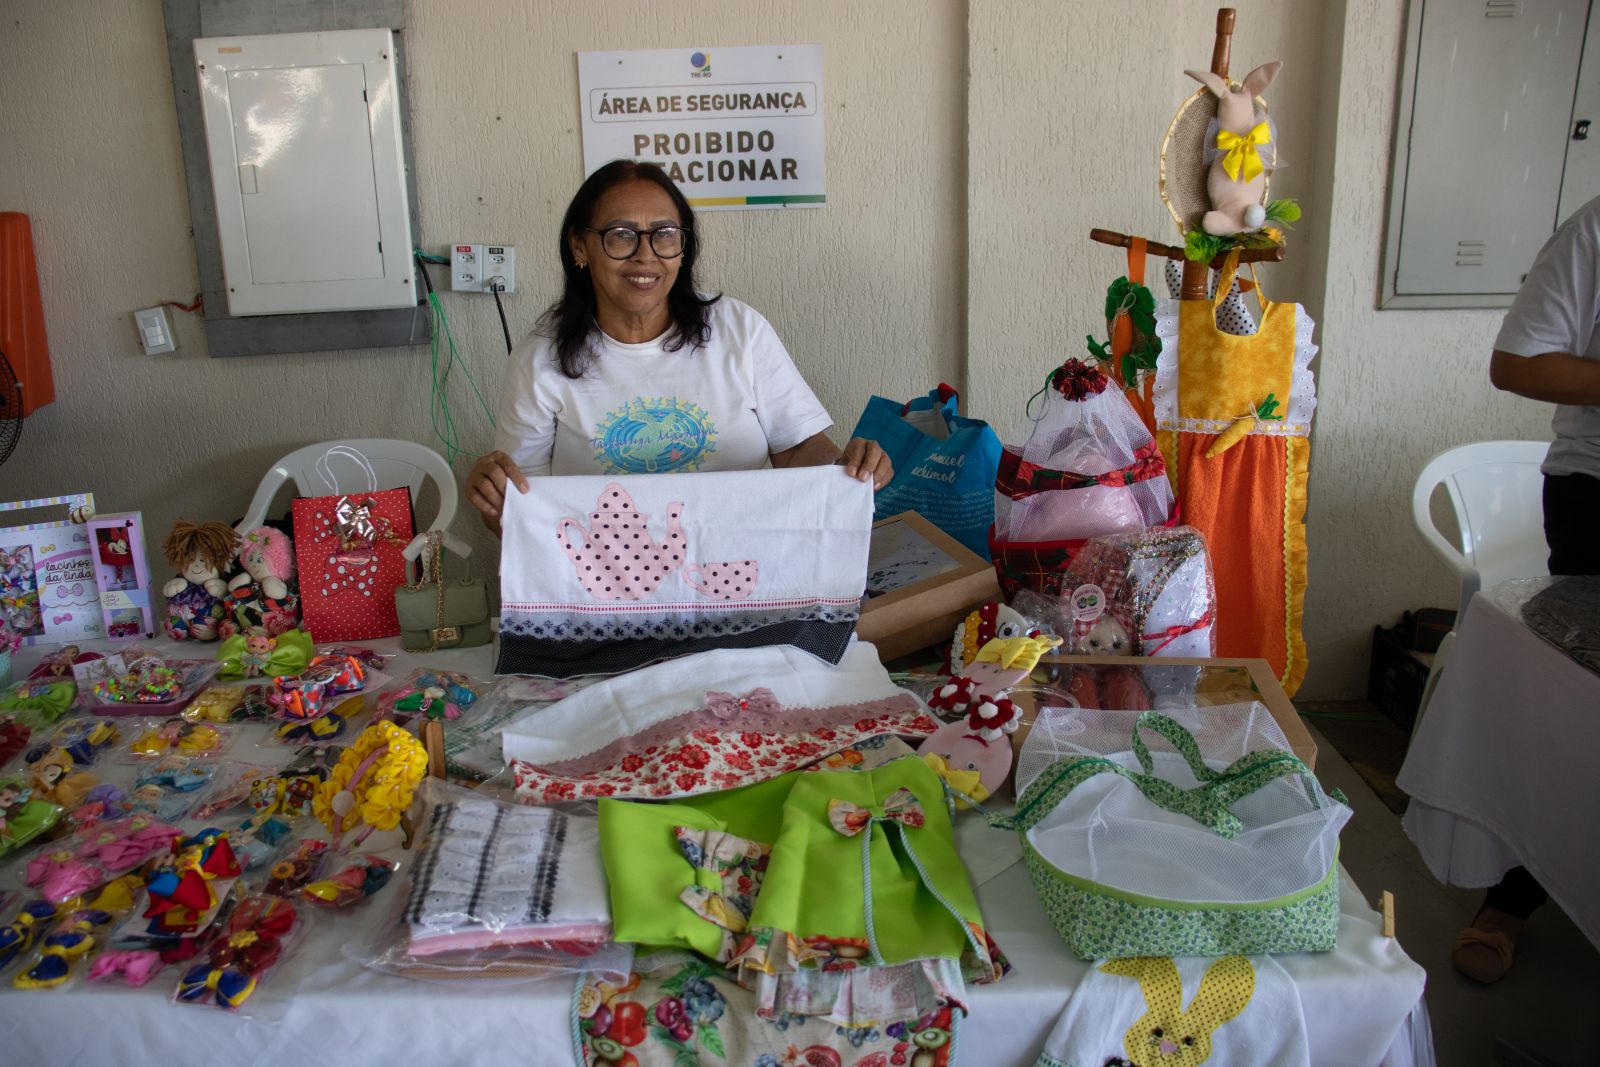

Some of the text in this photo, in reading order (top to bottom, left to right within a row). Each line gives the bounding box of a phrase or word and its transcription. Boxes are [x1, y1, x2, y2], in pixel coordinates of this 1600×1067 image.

[599, 92, 807, 115] ÁREA DE SEGURANÇA
[634, 130, 775, 156] PROIBIDO
[654, 158, 799, 183] ACIONAR
[46, 570, 94, 583] da linda
